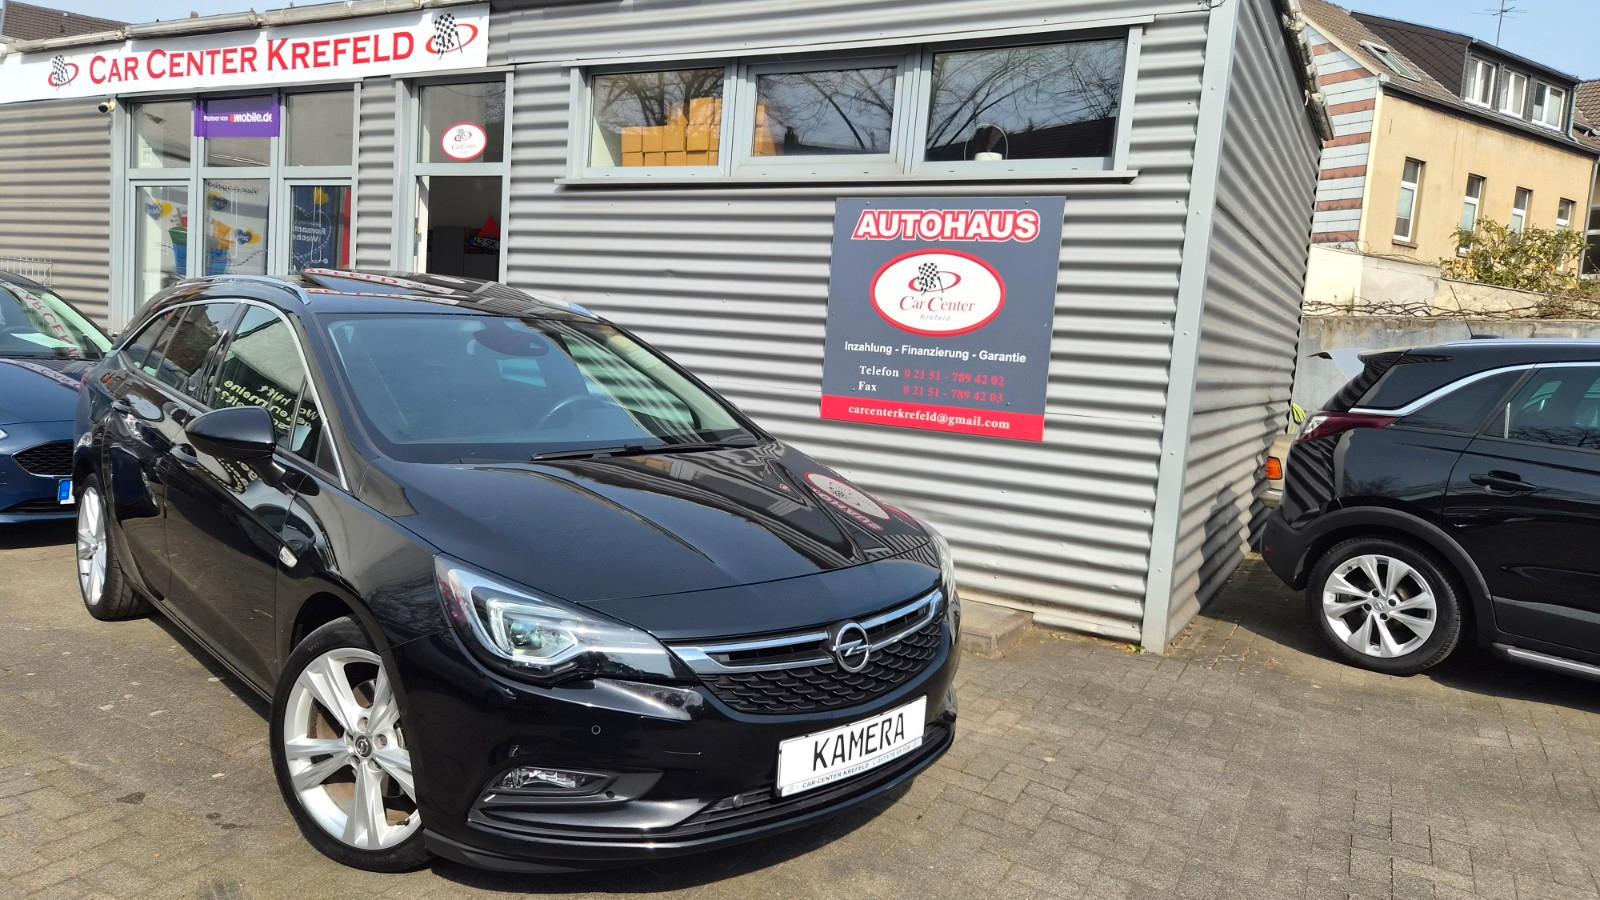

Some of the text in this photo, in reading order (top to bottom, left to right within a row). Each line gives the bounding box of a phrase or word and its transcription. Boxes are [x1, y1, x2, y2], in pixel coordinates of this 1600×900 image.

[89, 32, 414, 84] CAR CENTER KREFELD
[851, 209, 1040, 242] AUTOHAUS
[899, 295, 976, 312] Car Center
[845, 341, 893, 356] Inzahlung
[901, 345, 970, 361] Finanzierung
[979, 350, 1027, 364] Garantie
[859, 366, 900, 378] Telefon
[858, 381, 877, 392] Fax
[848, 406, 1010, 430] carcenterkrefeld@gmail.com
[813, 713, 905, 772] KAMERA
